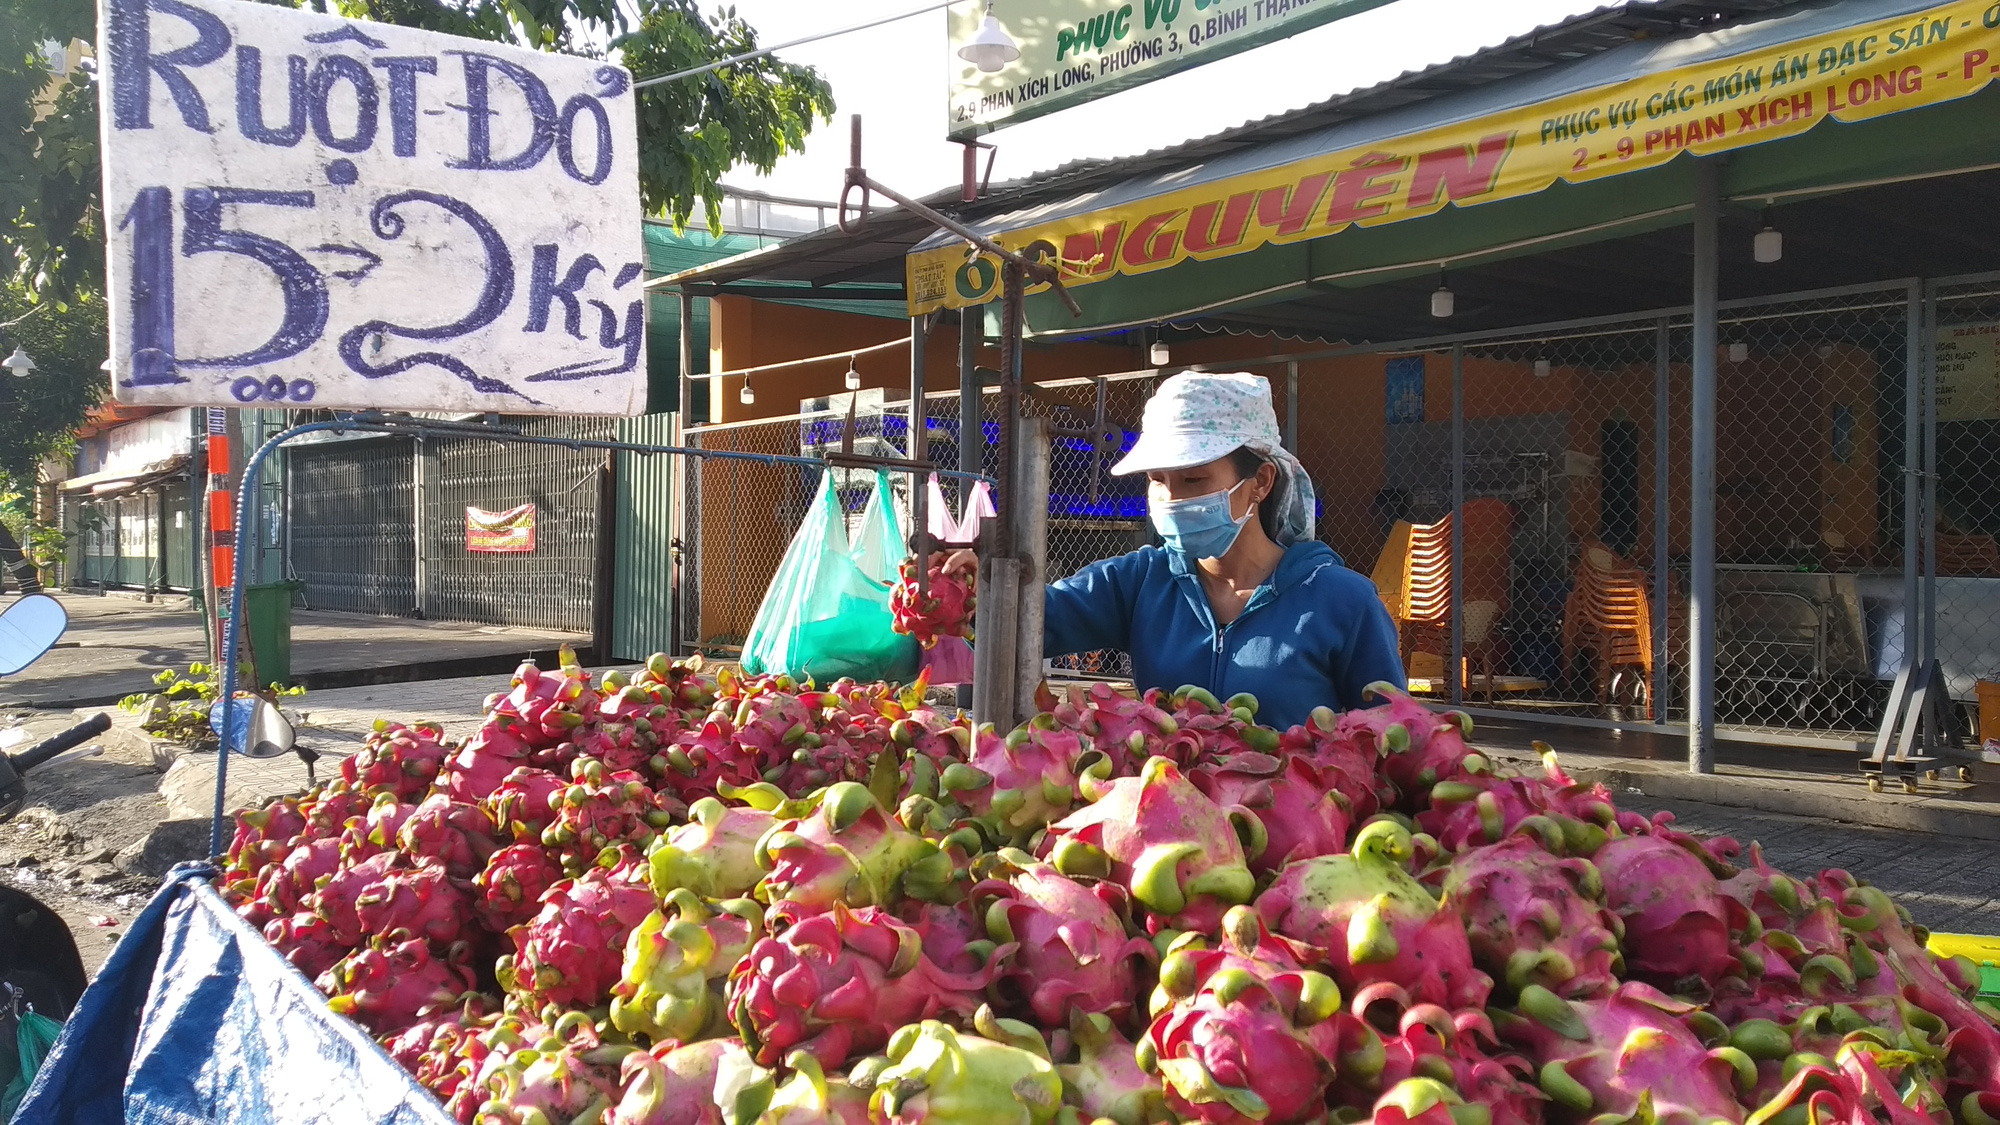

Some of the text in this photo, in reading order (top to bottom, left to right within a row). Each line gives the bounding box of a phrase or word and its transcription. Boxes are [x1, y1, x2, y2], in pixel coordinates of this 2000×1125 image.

[980, 87, 1014, 115] PHAN
[1018, 77, 1049, 104] XÍCH
[1054, 62, 1095, 91] LONG,
[1100, 37, 1162, 76] PHƯỜNG
[1168, 32, 1183, 54] 3,
[1189, 5, 1248, 46] Q.BÌNH
[1056, 3, 1133, 62] PHỤC
[1541, 107, 1600, 145] PHỤC
[1608, 98, 1639, 131] VỤ
[1646, 80, 1695, 120] CÁC
[1703, 65, 1763, 107] MÓN
[1769, 53, 1809, 88] ĂN
[1817, 35, 1877, 76] ĐẶC
[1886, 16, 1952, 55] SẢN
[1645, 112, 1726, 154] PHAN
[1737, 91, 1812, 134] XÍCH
[1827, 65, 1922, 113] LONG
[1059, 130, 1518, 280] NGUYÊN
